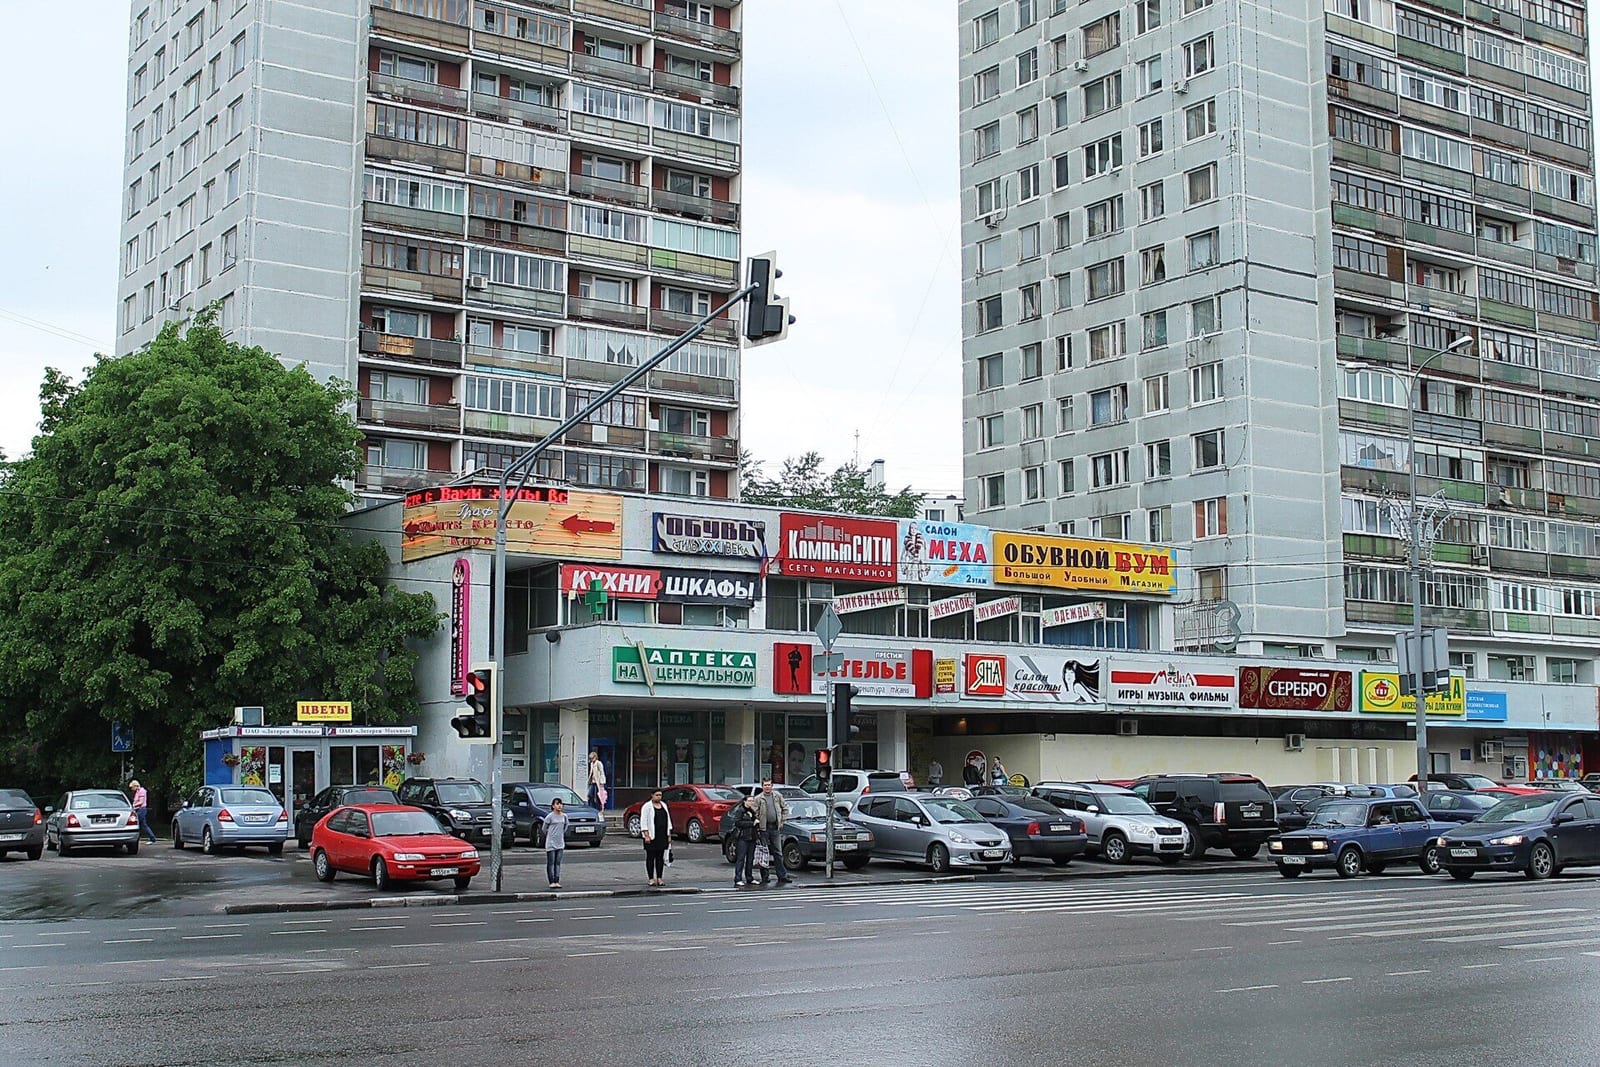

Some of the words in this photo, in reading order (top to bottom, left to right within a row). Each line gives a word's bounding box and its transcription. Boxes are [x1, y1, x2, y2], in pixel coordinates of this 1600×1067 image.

[440, 487, 482, 501] Вами
[666, 517, 755, 542] ОБУВЬ
[925, 525, 958, 537] САЛОН
[928, 539, 988, 564] МЕХА
[1004, 543, 1109, 569] ОБУВНОЙ
[1115, 551, 1169, 575] БУМ
[788, 563, 816, 573] СЕТЬ
[825, 566, 893, 578] МАГАЗИНОВ
[572, 570, 651, 593] КУХНИ
[665, 576, 755, 600] ШКАФЫ
[839, 589, 900, 611] ЛИКВИДАЦИЯ
[932, 597, 970, 616] ЖЕНСКОЙ
[978, 599, 1016, 619] МУЖСКОЙ
[1054, 606, 1090, 622] ОДЕЖДЫ
[650, 650, 754, 667] АПТЕКА
[875, 651, 904, 659] ПРЕСТИЖ
[619, 665, 639, 678] НА
[657, 667, 754, 683] ЦЕНТРАЛЬНОМ
[818, 660, 907, 680] ТЕЛЬЕ
[970, 660, 1003, 690] ЯНА
[1015, 669, 1048, 681] Салон
[1013, 682, 1061, 693] красоты
[1268, 680, 1327, 697] СЕРЕБРО
[1118, 690, 1143, 700] ИГРЫ
[1147, 691, 1185, 702] МУЗЫКА
[1190, 692, 1229, 703] ФИЛЬМЫ
[301, 705, 349, 715] ЦВЕТЫ
